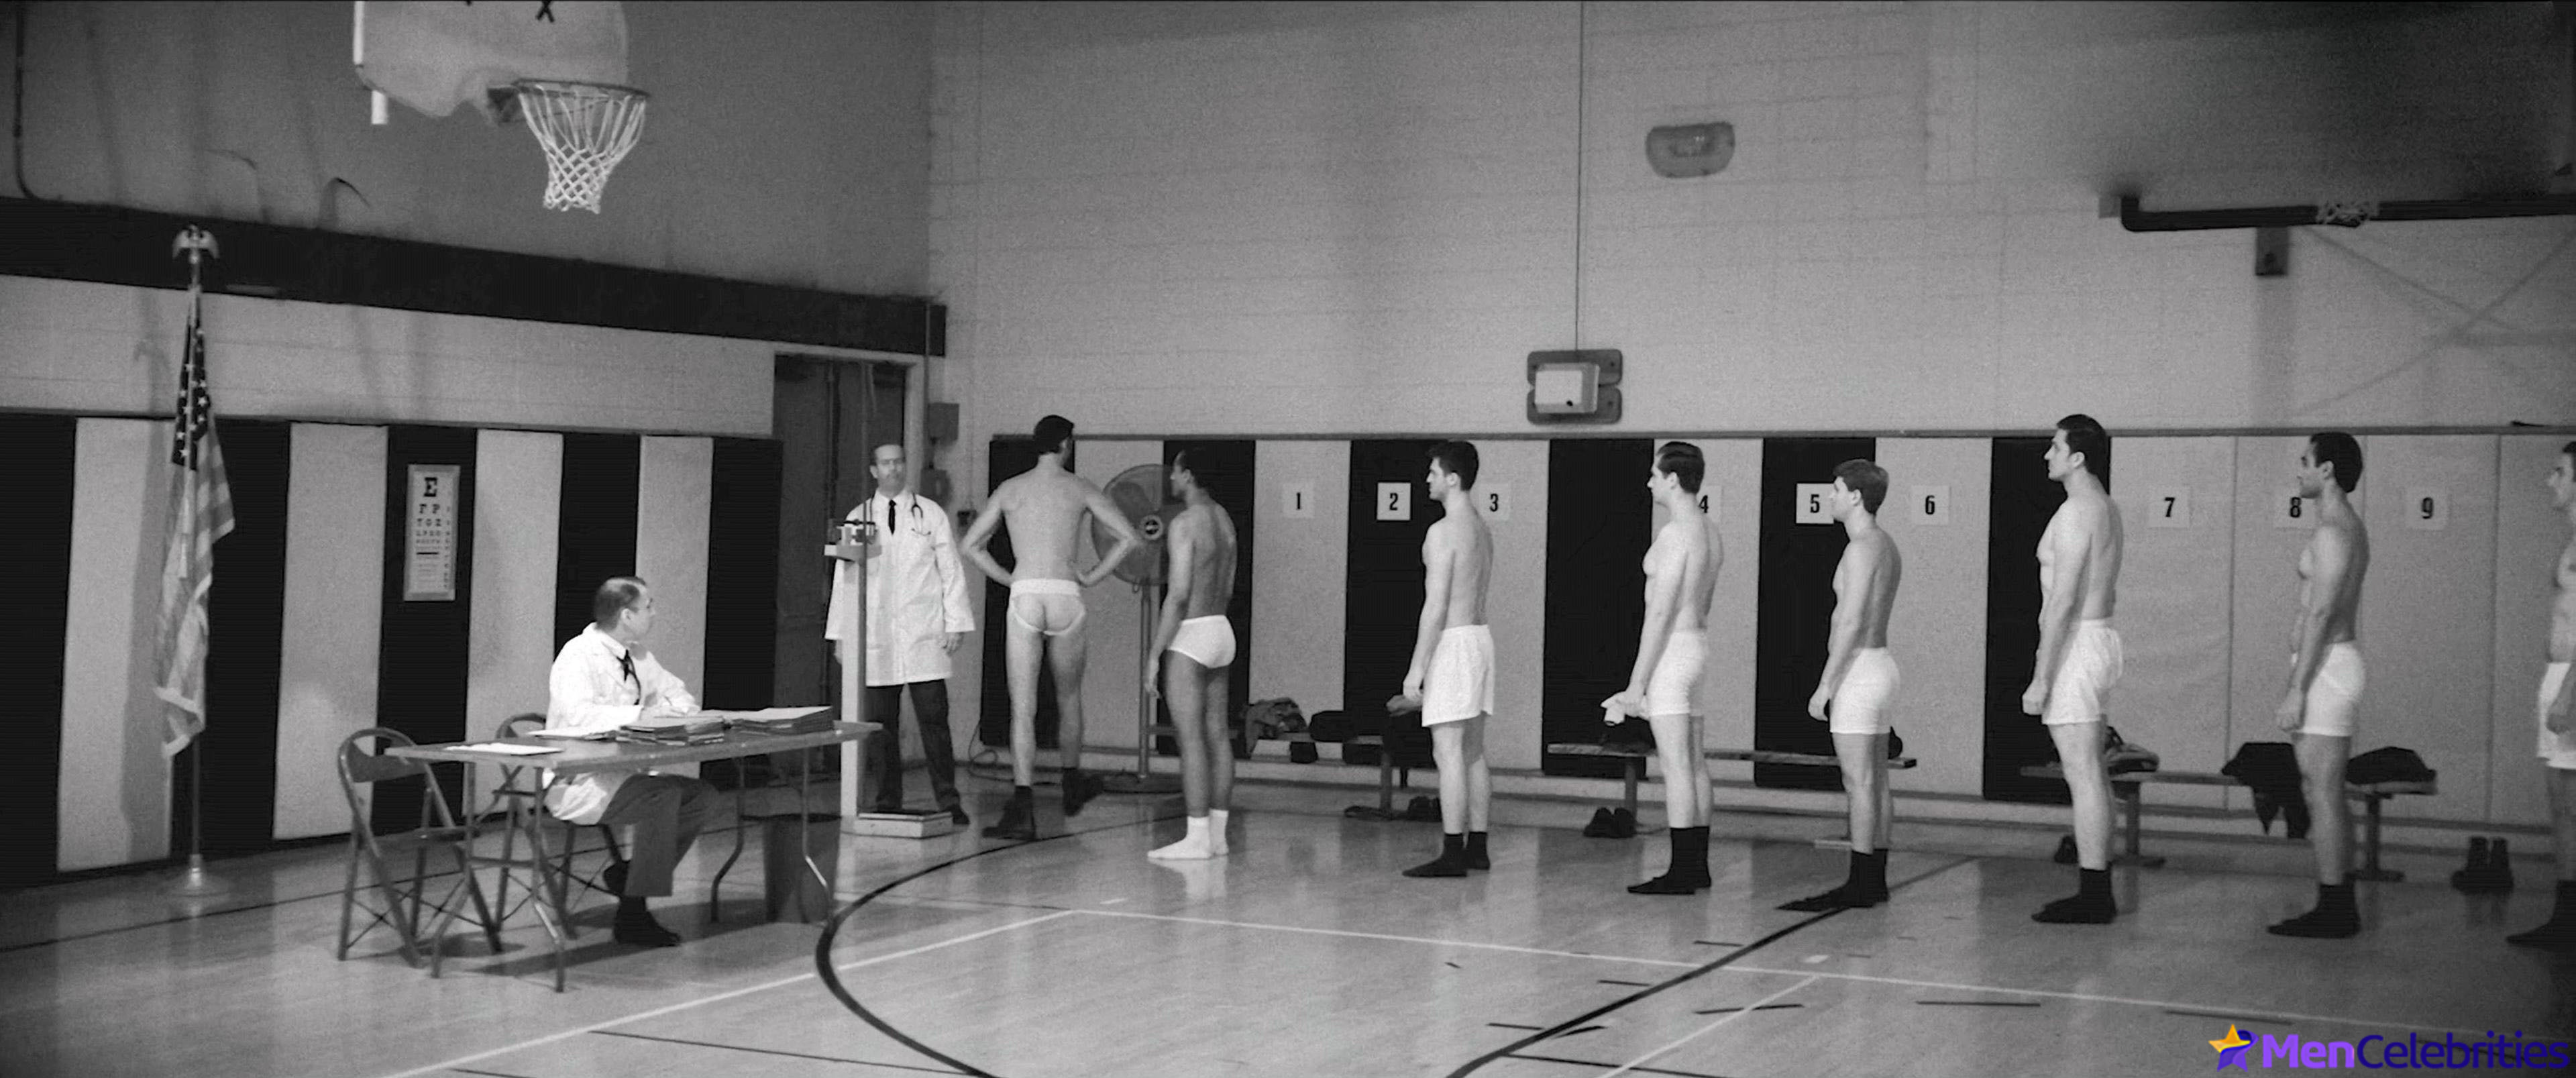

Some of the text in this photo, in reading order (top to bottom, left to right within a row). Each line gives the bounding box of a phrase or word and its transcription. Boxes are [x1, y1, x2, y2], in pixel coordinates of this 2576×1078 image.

[423, 477, 438, 498] E
[1295, 492, 1301, 510] 1
[1389, 492, 1399, 511] 2
[1489, 493, 1499, 513] 3
[1698, 494, 1709, 514] 4
[1810, 494, 1821, 514] 5
[1925, 495, 1935, 515] 6
[2164, 496, 2176, 518] 7
[2289, 496, 2302, 519] 8
[2421, 497, 2434, 520] 9
